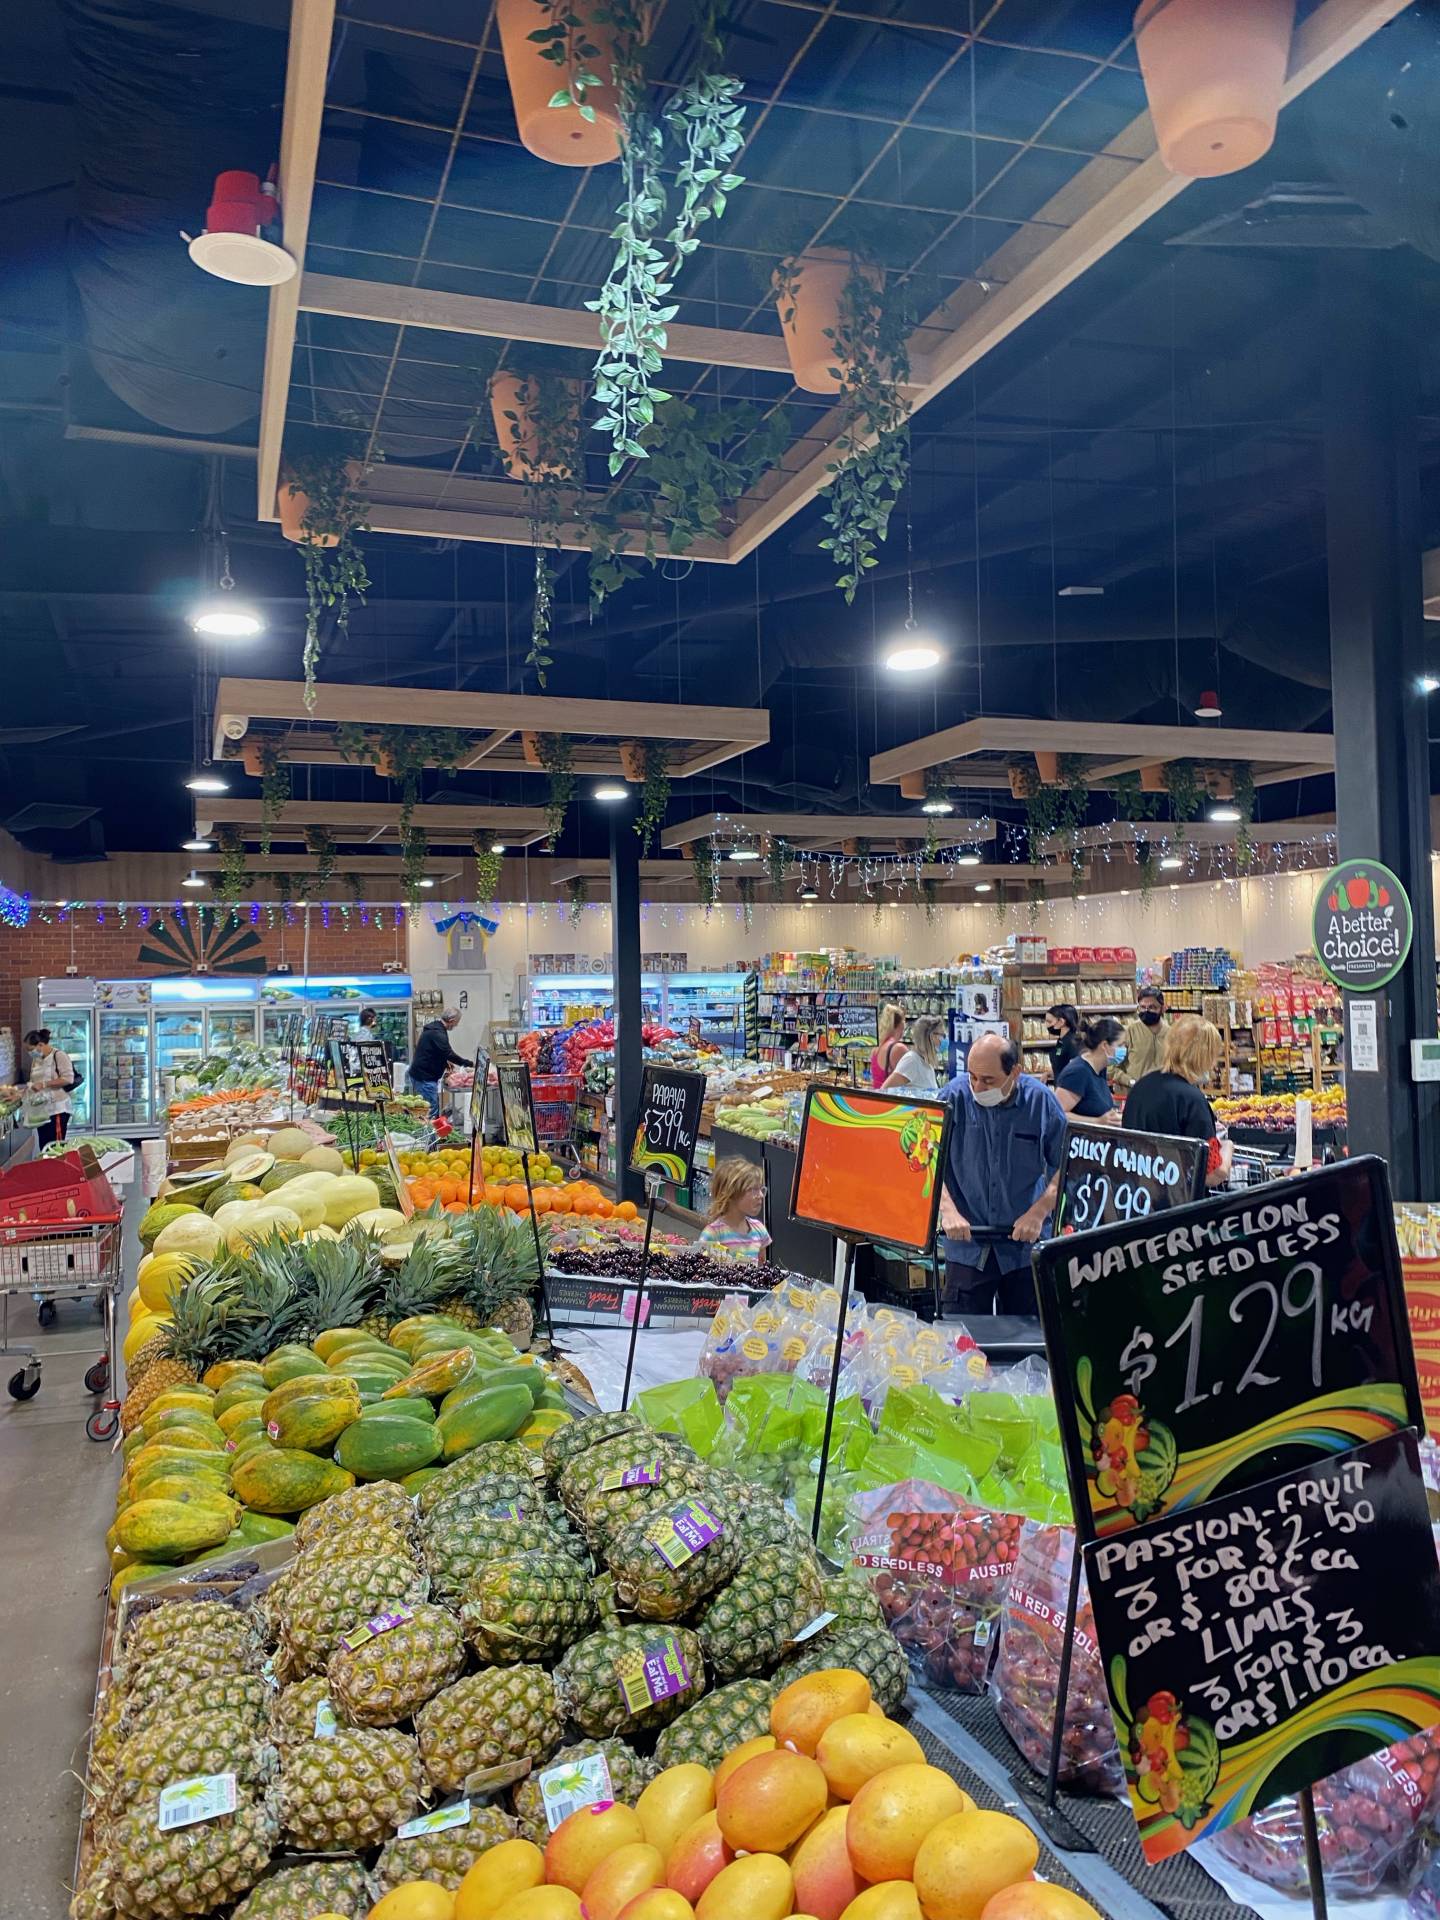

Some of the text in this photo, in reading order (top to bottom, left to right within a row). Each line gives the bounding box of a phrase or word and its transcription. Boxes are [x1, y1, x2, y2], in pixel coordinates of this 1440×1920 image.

[1323, 928, 1400, 959] choice!
[1328, 911, 1392, 935] A better
[652, 1083, 686, 1112] PAPAYA
[1069, 1136, 1180, 1186] SILKY MANGO
[1067, 1197, 1309, 1290] WATERMELON
[1161, 1213, 1341, 1295] SEEDLESS
[587, 1290, 619, 1310] Fresh
[1119, 1261, 1324, 1414] $1.29
[675, 1519, 702, 1548] Eat Me!
[1095, 1461, 1371, 1581] PASSION-FRUIT
[871, 1556, 944, 1578] SEEDLESS
[1114, 1500, 1375, 1620] 3 FOR $2.50
[1025, 1595, 1050, 1619] RED
[1128, 1617, 1175, 1658] OR
[1311, 1548, 1360, 1571] ea
[1201, 1585, 1316, 1664] LIMES
[646, 1658, 666, 1697] Eat Me!
[1189, 1675, 1231, 1711] 3
[1234, 1640, 1299, 1692] FOR
[1215, 1699, 1260, 1740] OR
